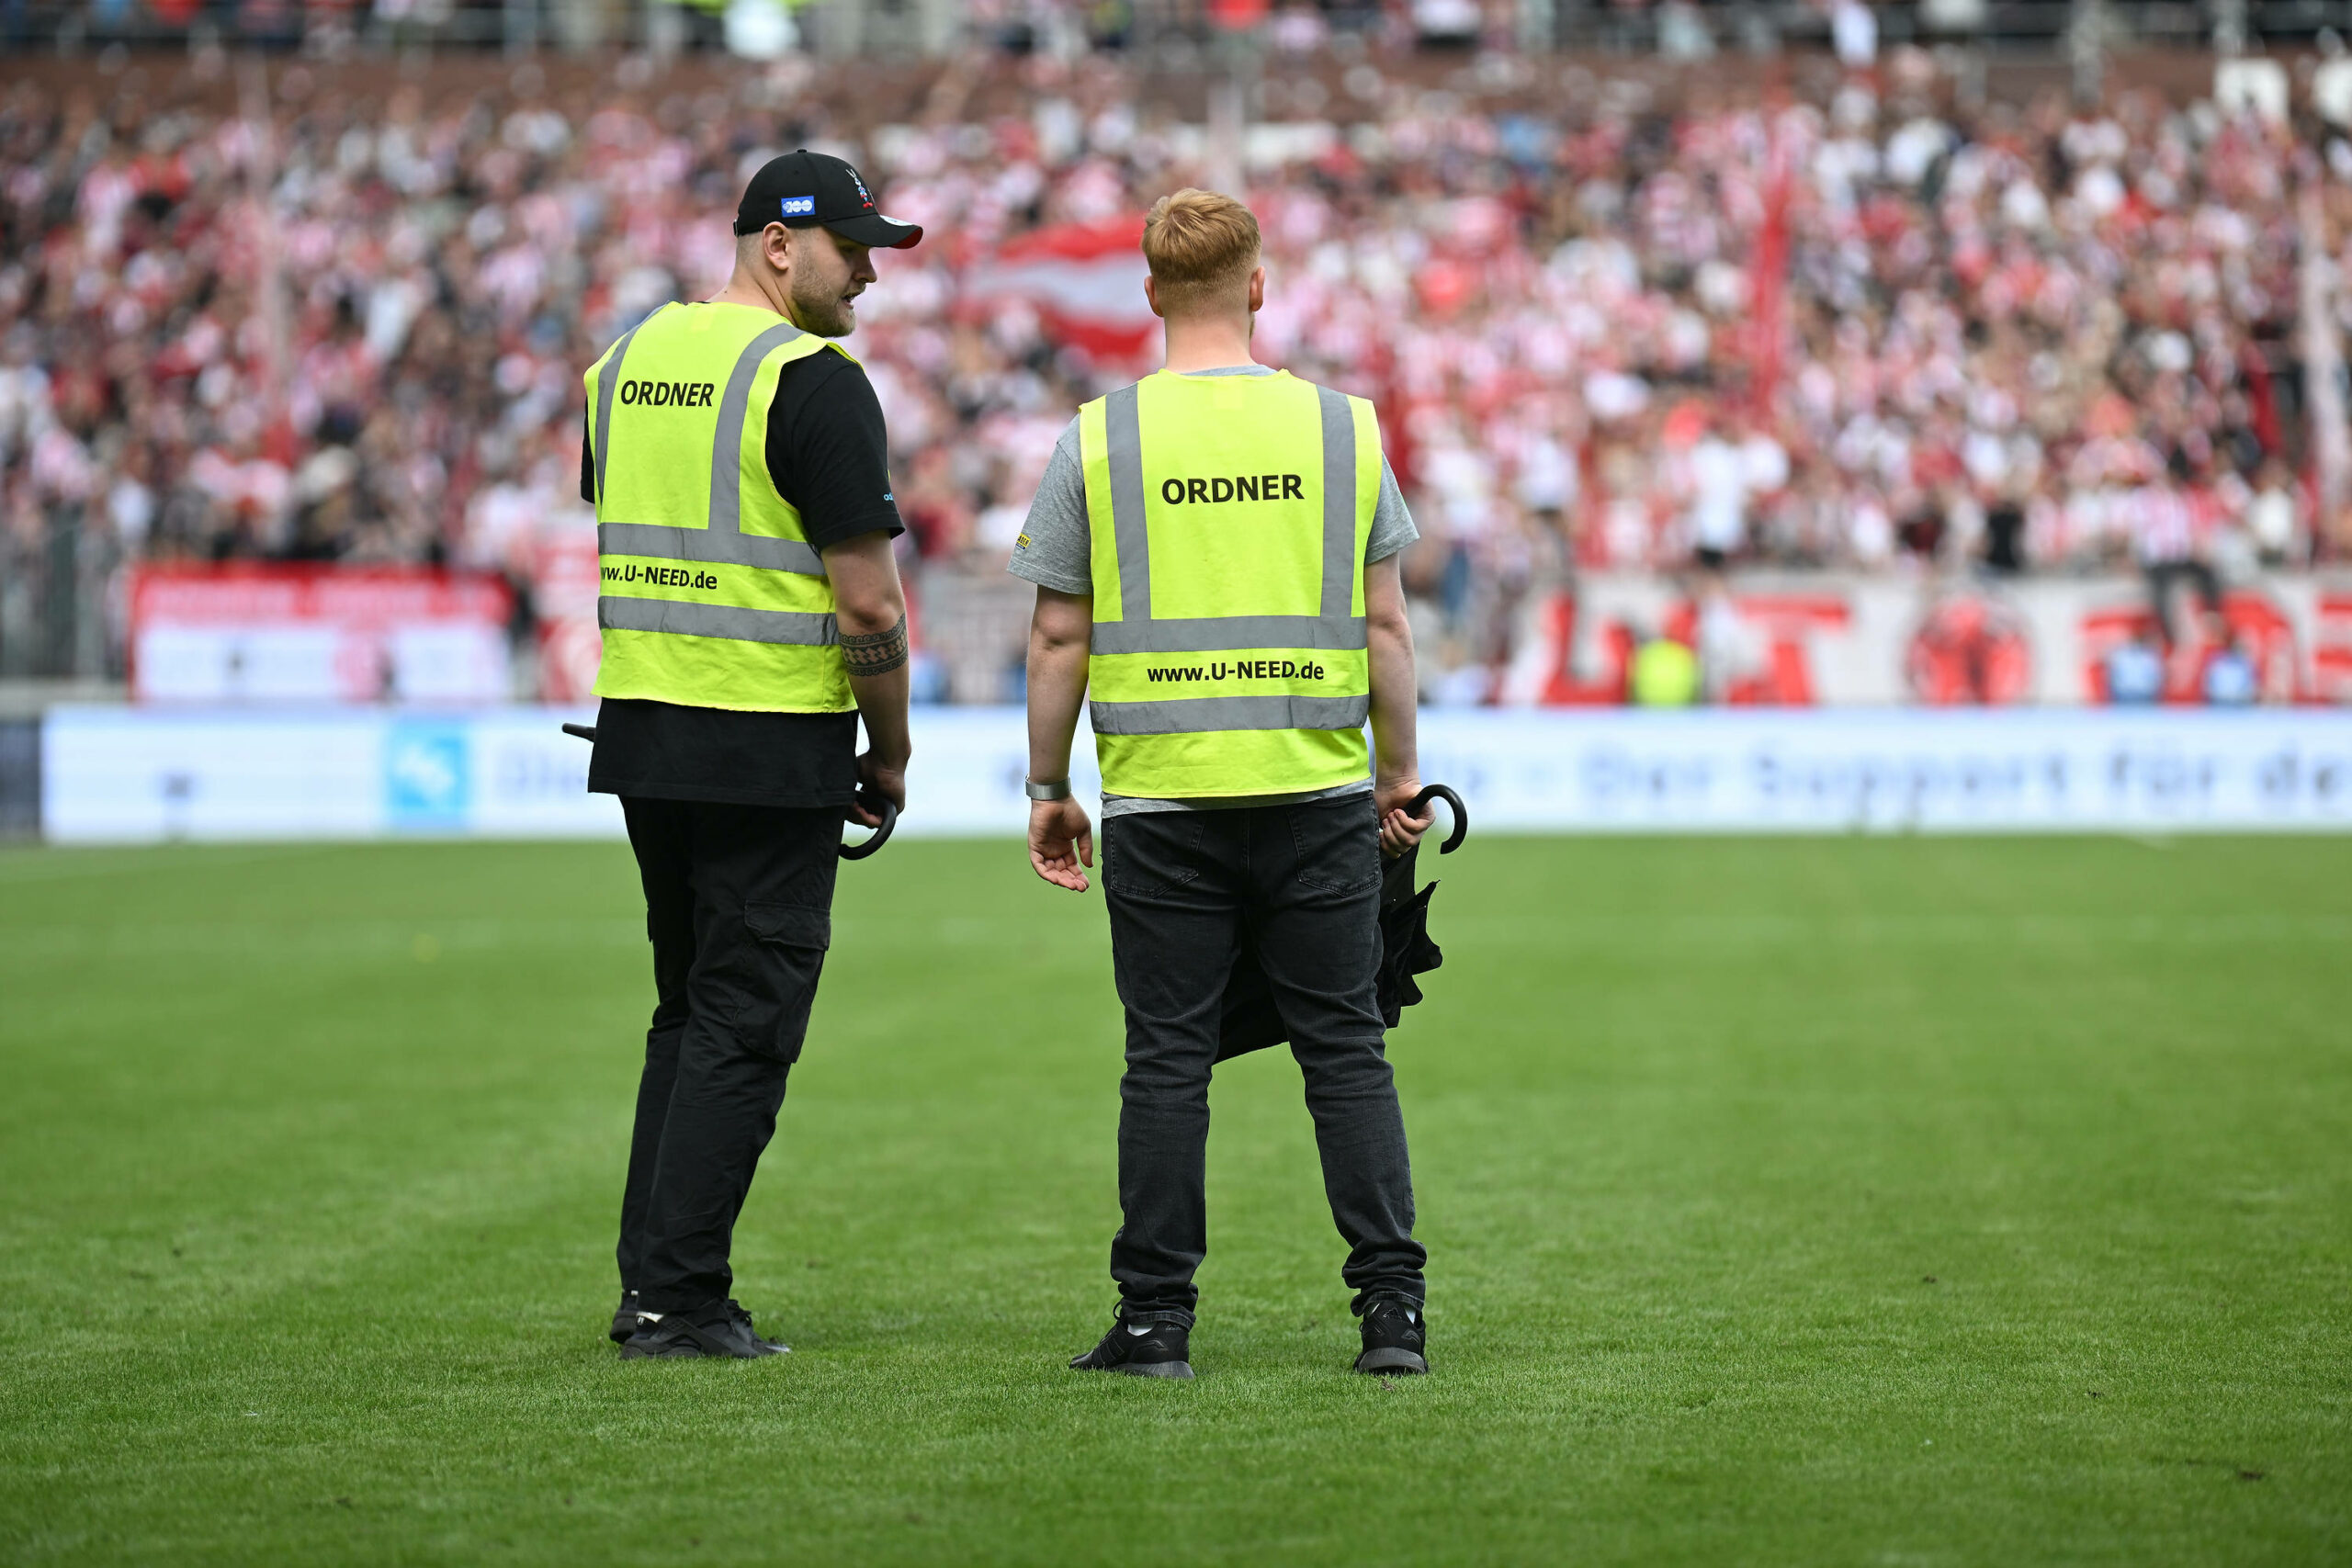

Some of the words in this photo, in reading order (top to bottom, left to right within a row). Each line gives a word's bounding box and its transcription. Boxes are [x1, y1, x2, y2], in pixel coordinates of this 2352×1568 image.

[620, 379, 715, 407] ORDNER
[1161, 474, 1305, 505] ORDNER
[1147, 660, 1325, 682] www.U-NEED.de
